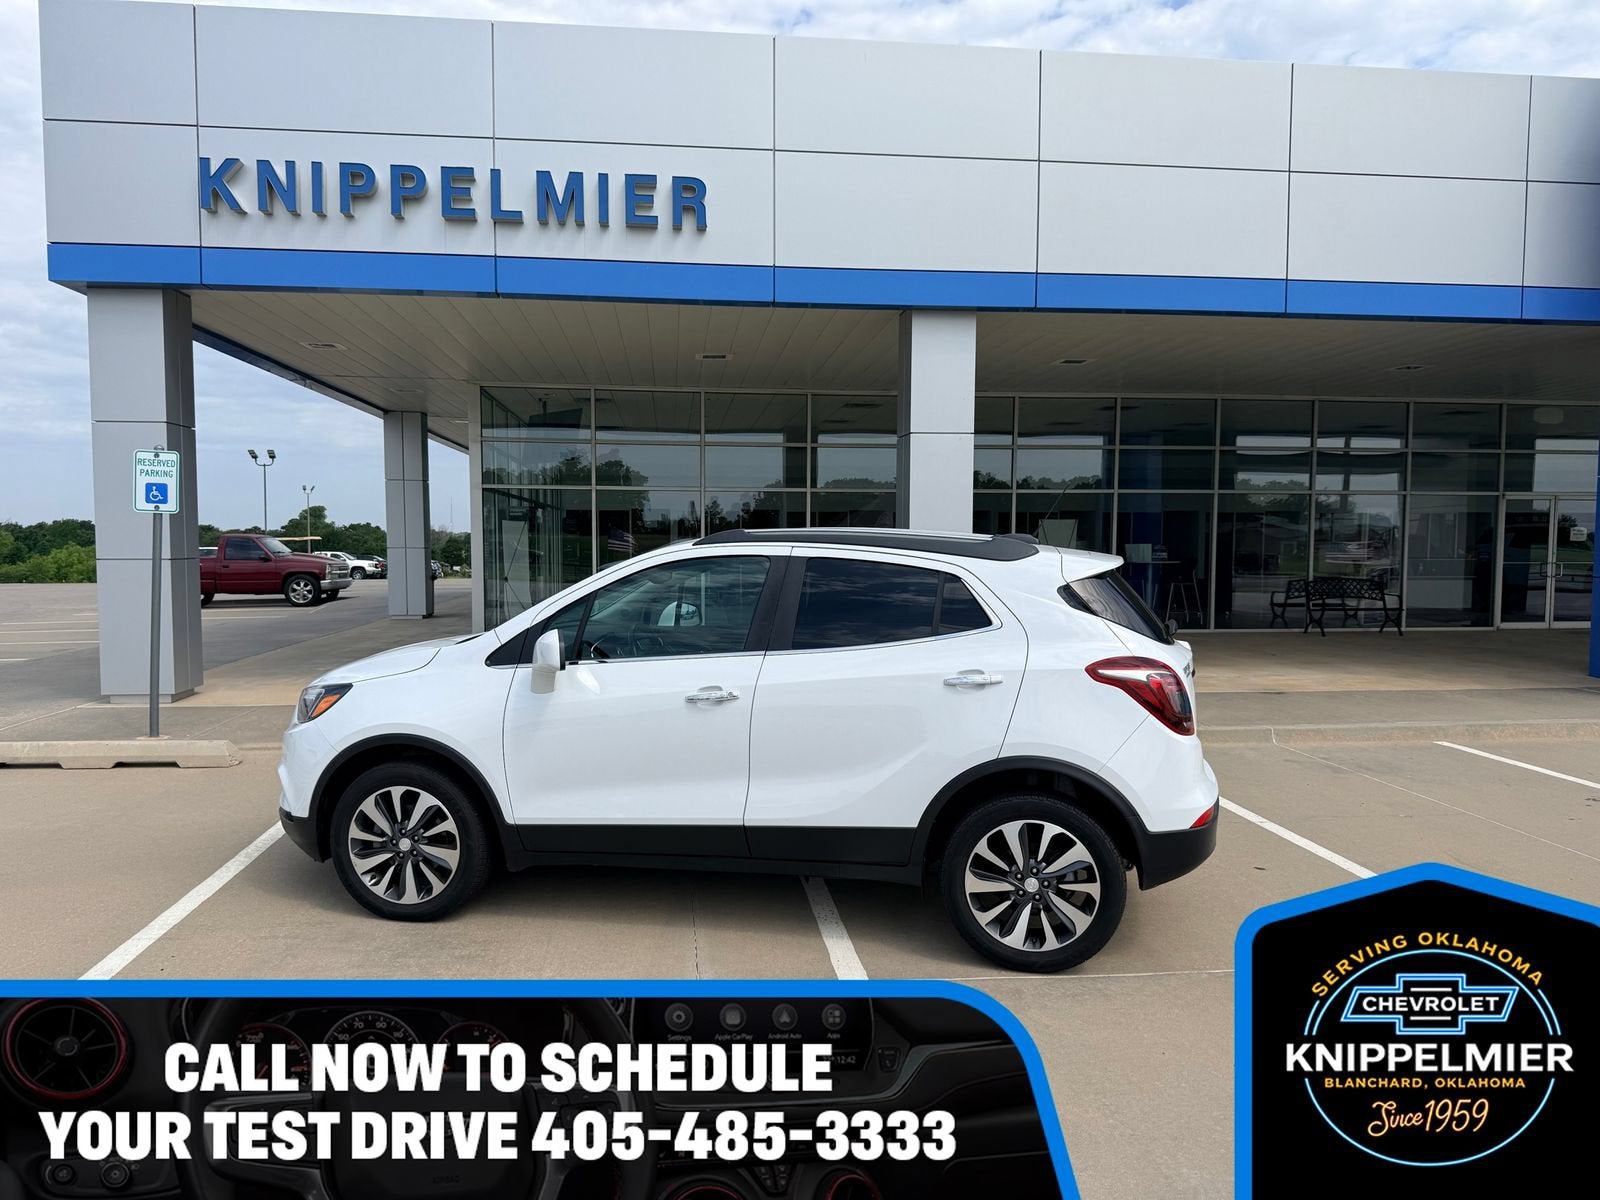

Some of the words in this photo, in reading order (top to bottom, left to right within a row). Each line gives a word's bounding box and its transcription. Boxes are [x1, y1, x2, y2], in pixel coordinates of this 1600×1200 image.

[199, 157, 708, 231] KNIPPELMIER
[137, 458, 176, 468] RESERVED
[139, 469, 174, 478] PARKING
